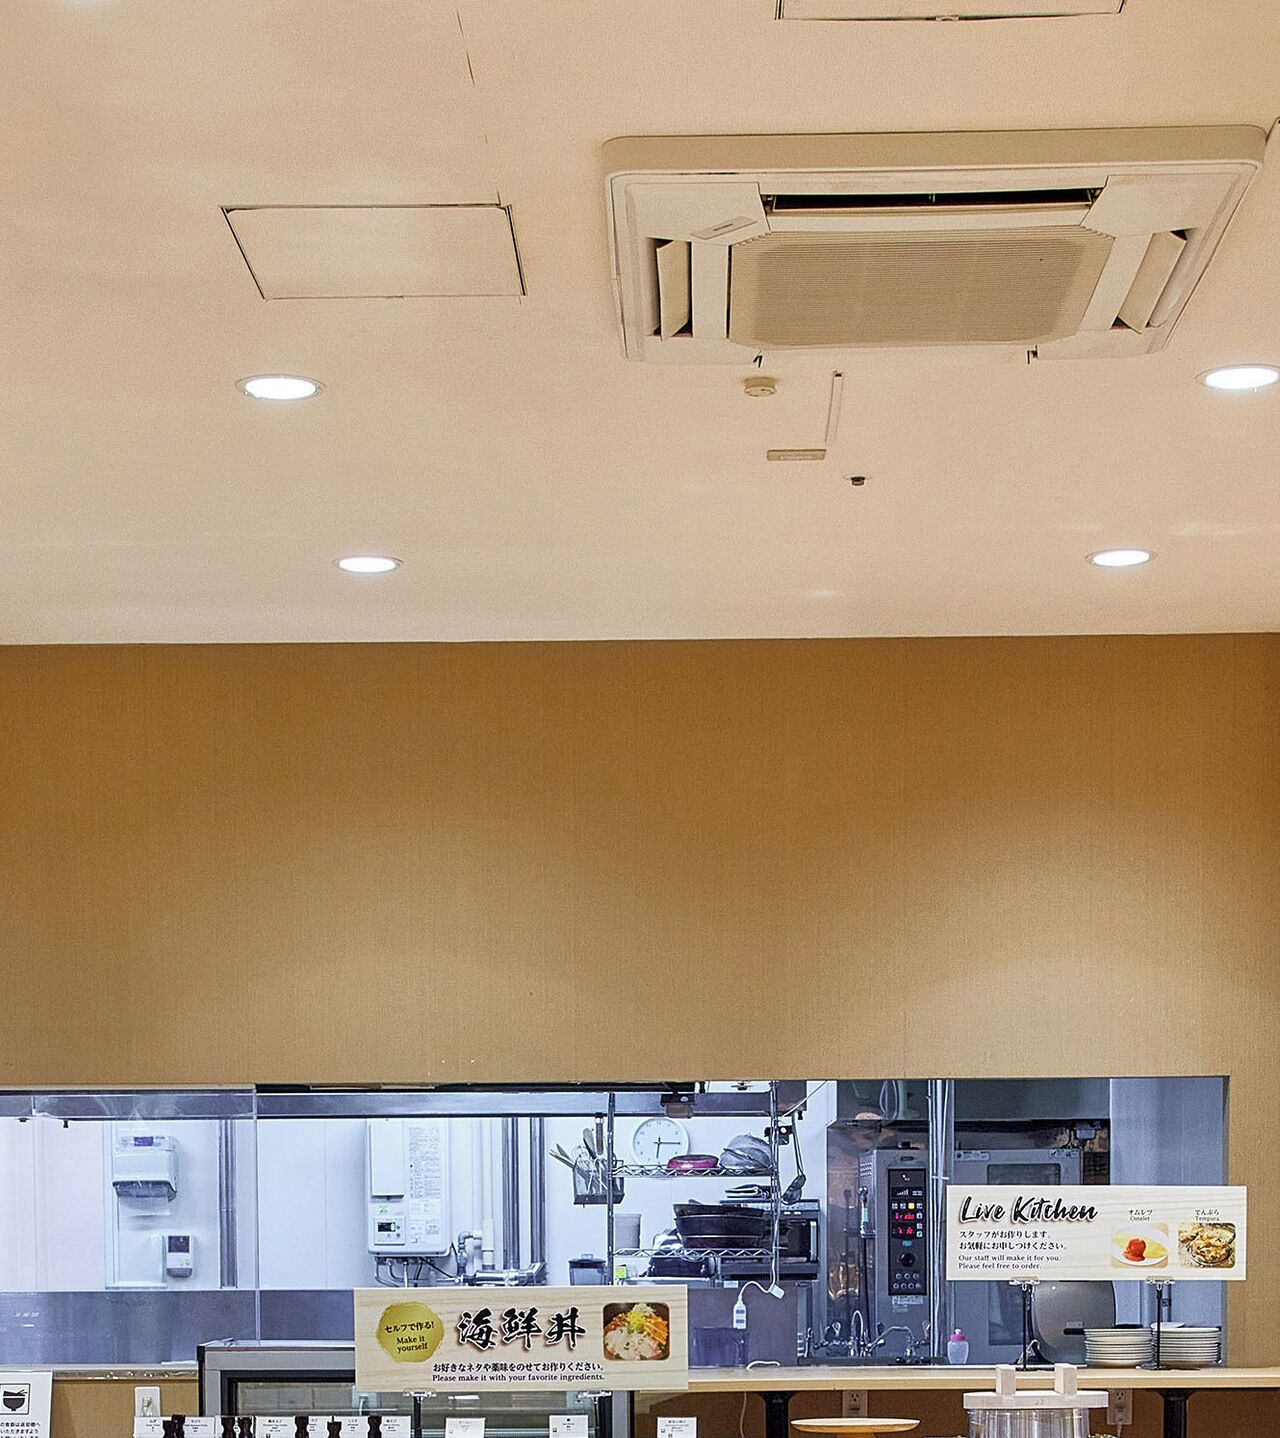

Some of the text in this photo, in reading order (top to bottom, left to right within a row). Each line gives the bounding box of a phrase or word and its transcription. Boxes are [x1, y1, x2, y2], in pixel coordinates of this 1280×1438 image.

[961, 1196, 1098, 1221] Live Kitchen
[960, 1230, 1051, 1239] スタッフがお作りします。
[959, 1242, 1066, 1250] お気軽にお申しつけください。
[385, 1321, 435, 1333] セルフで作る!
[458, 1307, 586, 1349] 海鮮丼
[396, 1336, 417, 1344] Make
[397, 1343, 428, 1353] yourself
[433, 1363, 604, 1372] お好きなネタや薬味をのせてお作りください。
[560, 1374, 604, 1382] ingredients.
